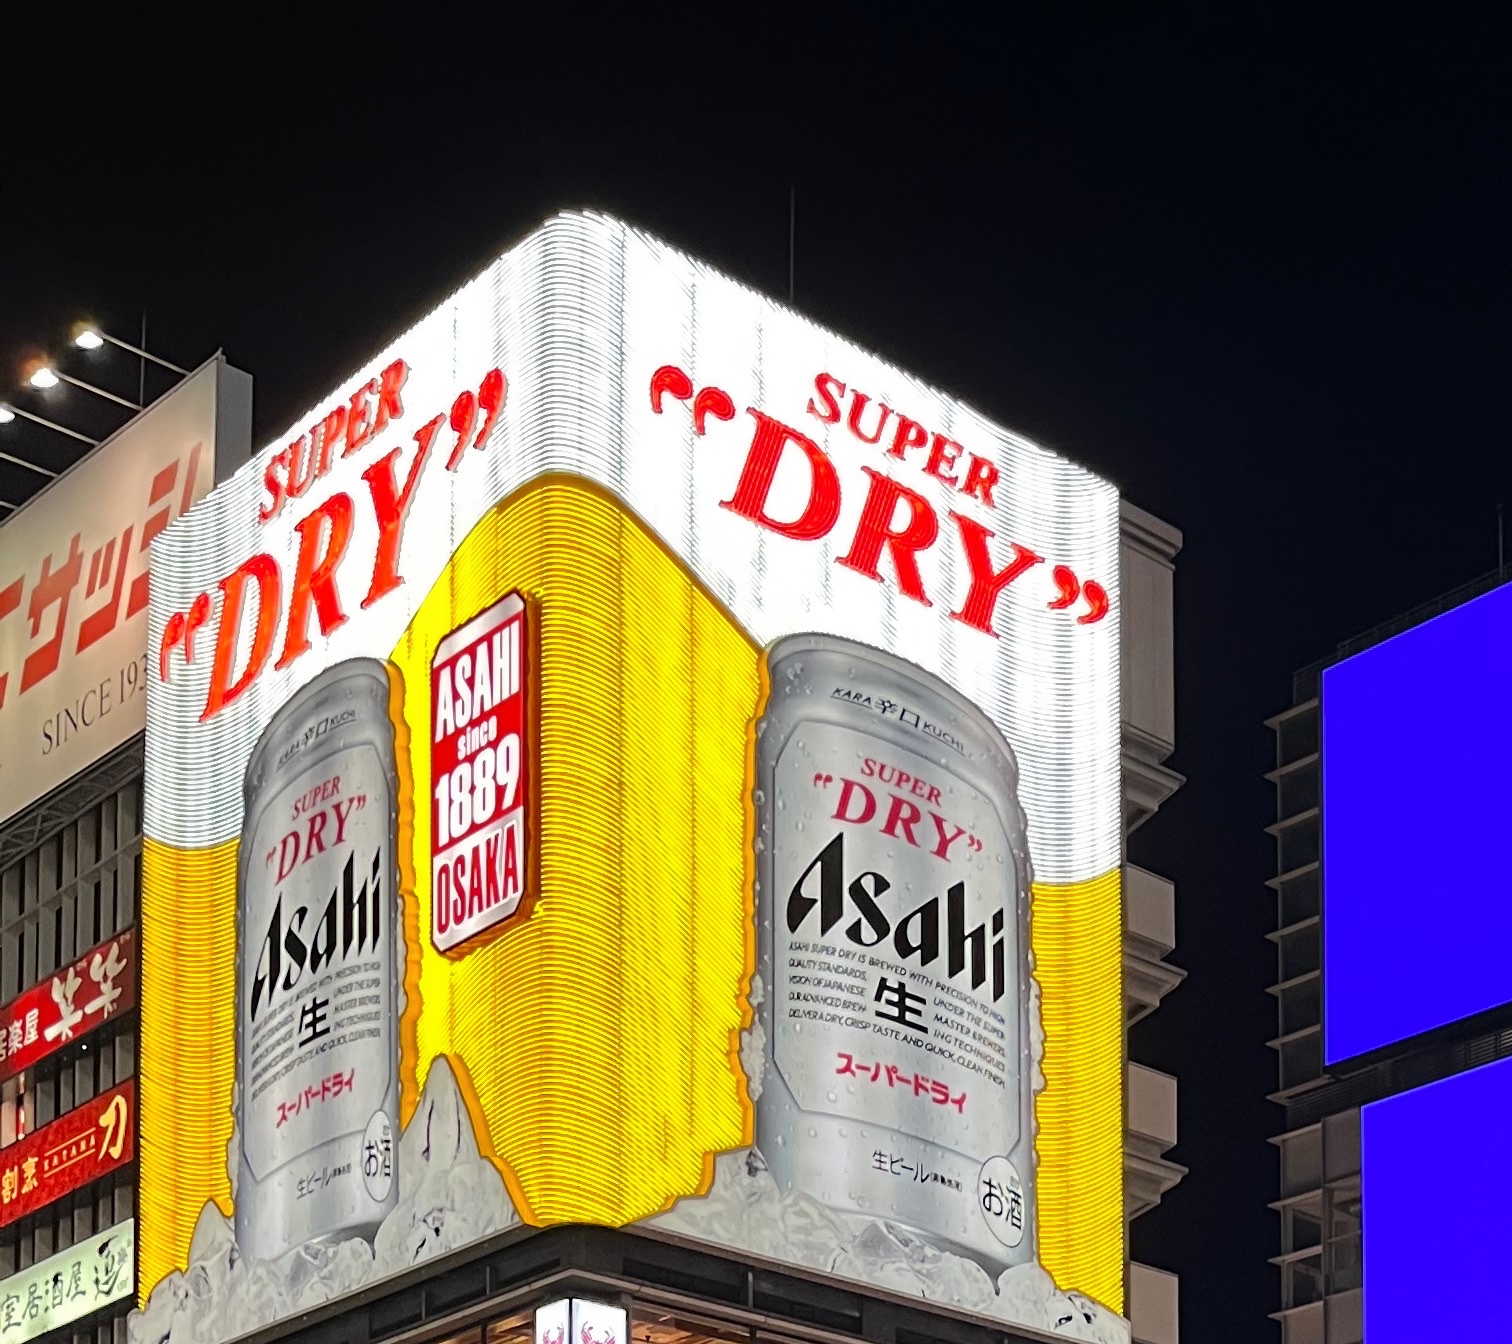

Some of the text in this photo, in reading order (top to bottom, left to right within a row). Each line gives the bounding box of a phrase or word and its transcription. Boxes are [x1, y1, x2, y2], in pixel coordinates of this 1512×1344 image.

[258, 357, 410, 524] SUPER
[806, 372, 1001, 508] SUPER
[41, 652, 148, 756] SINCE 193
[434, 621, 520, 743] ASAHI
[456, 715, 498, 760] since
[833, 686, 873, 706] KARA
[923, 721, 965, 752] KUCHI
[292, 775, 341, 821] SUPER
[434, 733, 520, 849] 1889
[860, 758, 943, 806] SUPER
[436, 823, 519, 936] OSAKA
[250, 846, 381, 1023] Asahi
[786, 831, 1005, 1003] Asahi
[298, 996, 331, 1048] 生
[873, 977, 929, 1034] 生
[275, 1067, 355, 1129] スーパードライ
[835, 1052, 968, 1114] スーパードライ
[98, 1094, 127, 1162] 刀
